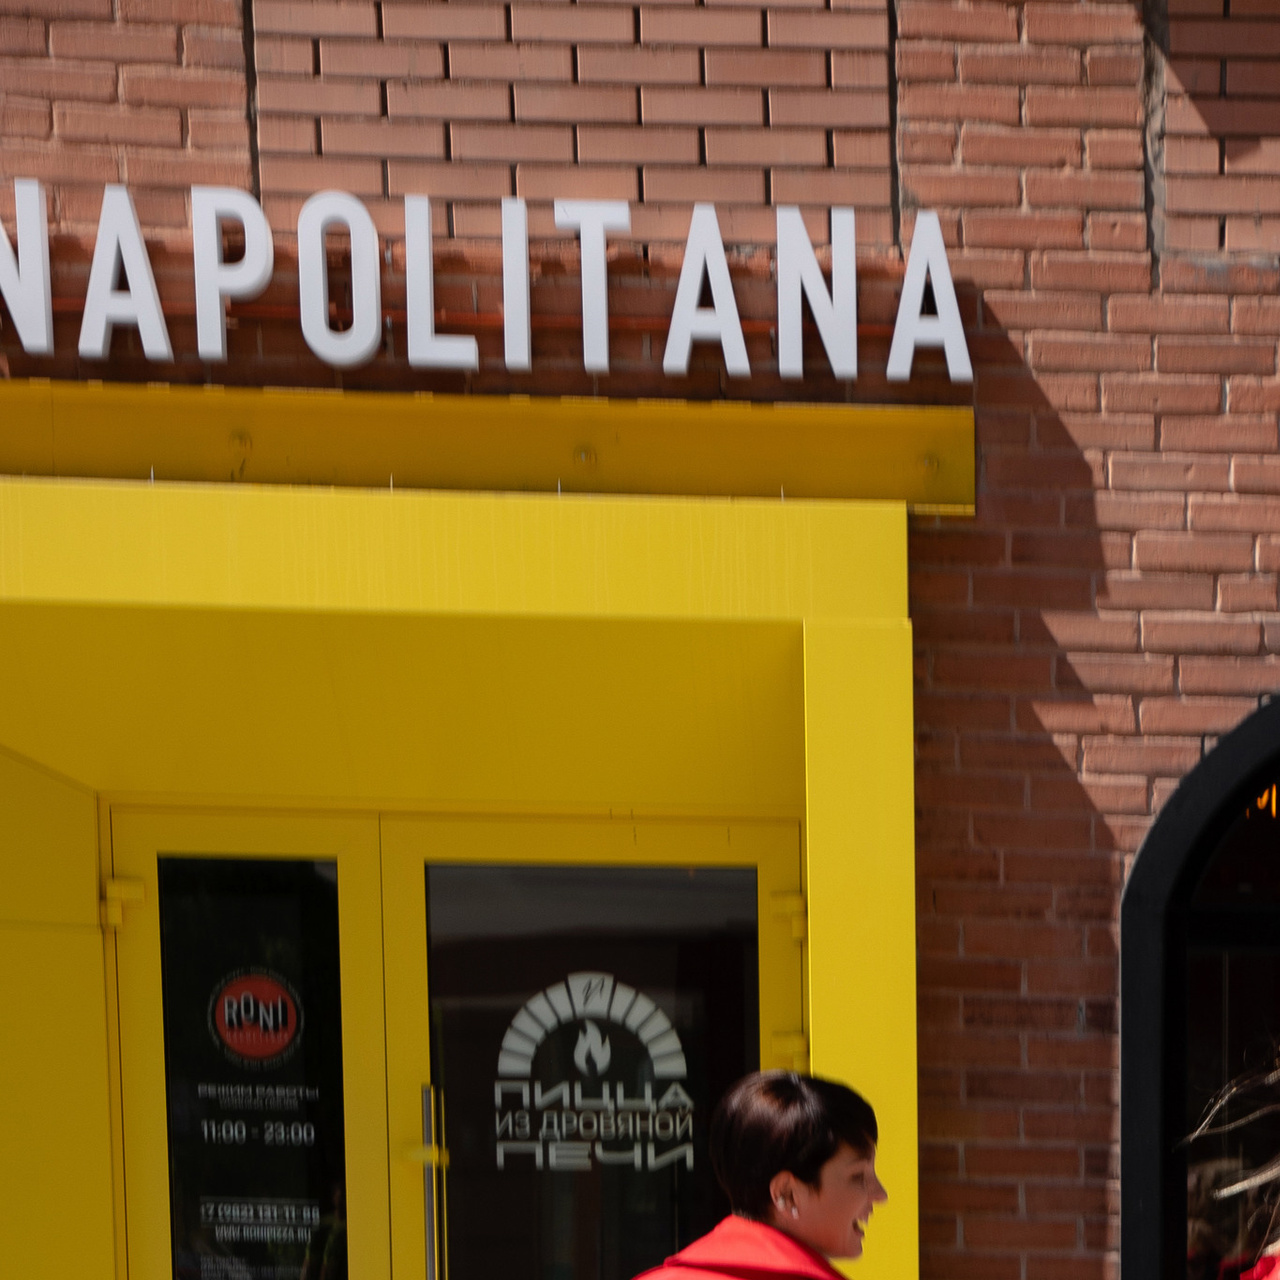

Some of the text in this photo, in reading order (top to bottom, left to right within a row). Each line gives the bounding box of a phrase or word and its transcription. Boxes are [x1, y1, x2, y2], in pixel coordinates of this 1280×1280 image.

[0, 178, 975, 383] NAPOLITANA
[224, 990, 285, 1032] RONI
[198, 1083, 319, 1100] РЕЖИМ РАБОТЫ
[494, 1080, 695, 1113] ПИЦЦА
[200, 1118, 247, 1145] 11:00
[264, 1120, 315, 1147] 23:00
[495, 1106, 694, 1141] ИЗ ДРОВЯНОЙ
[496, 1141, 695, 1171] ПЕЧИ
